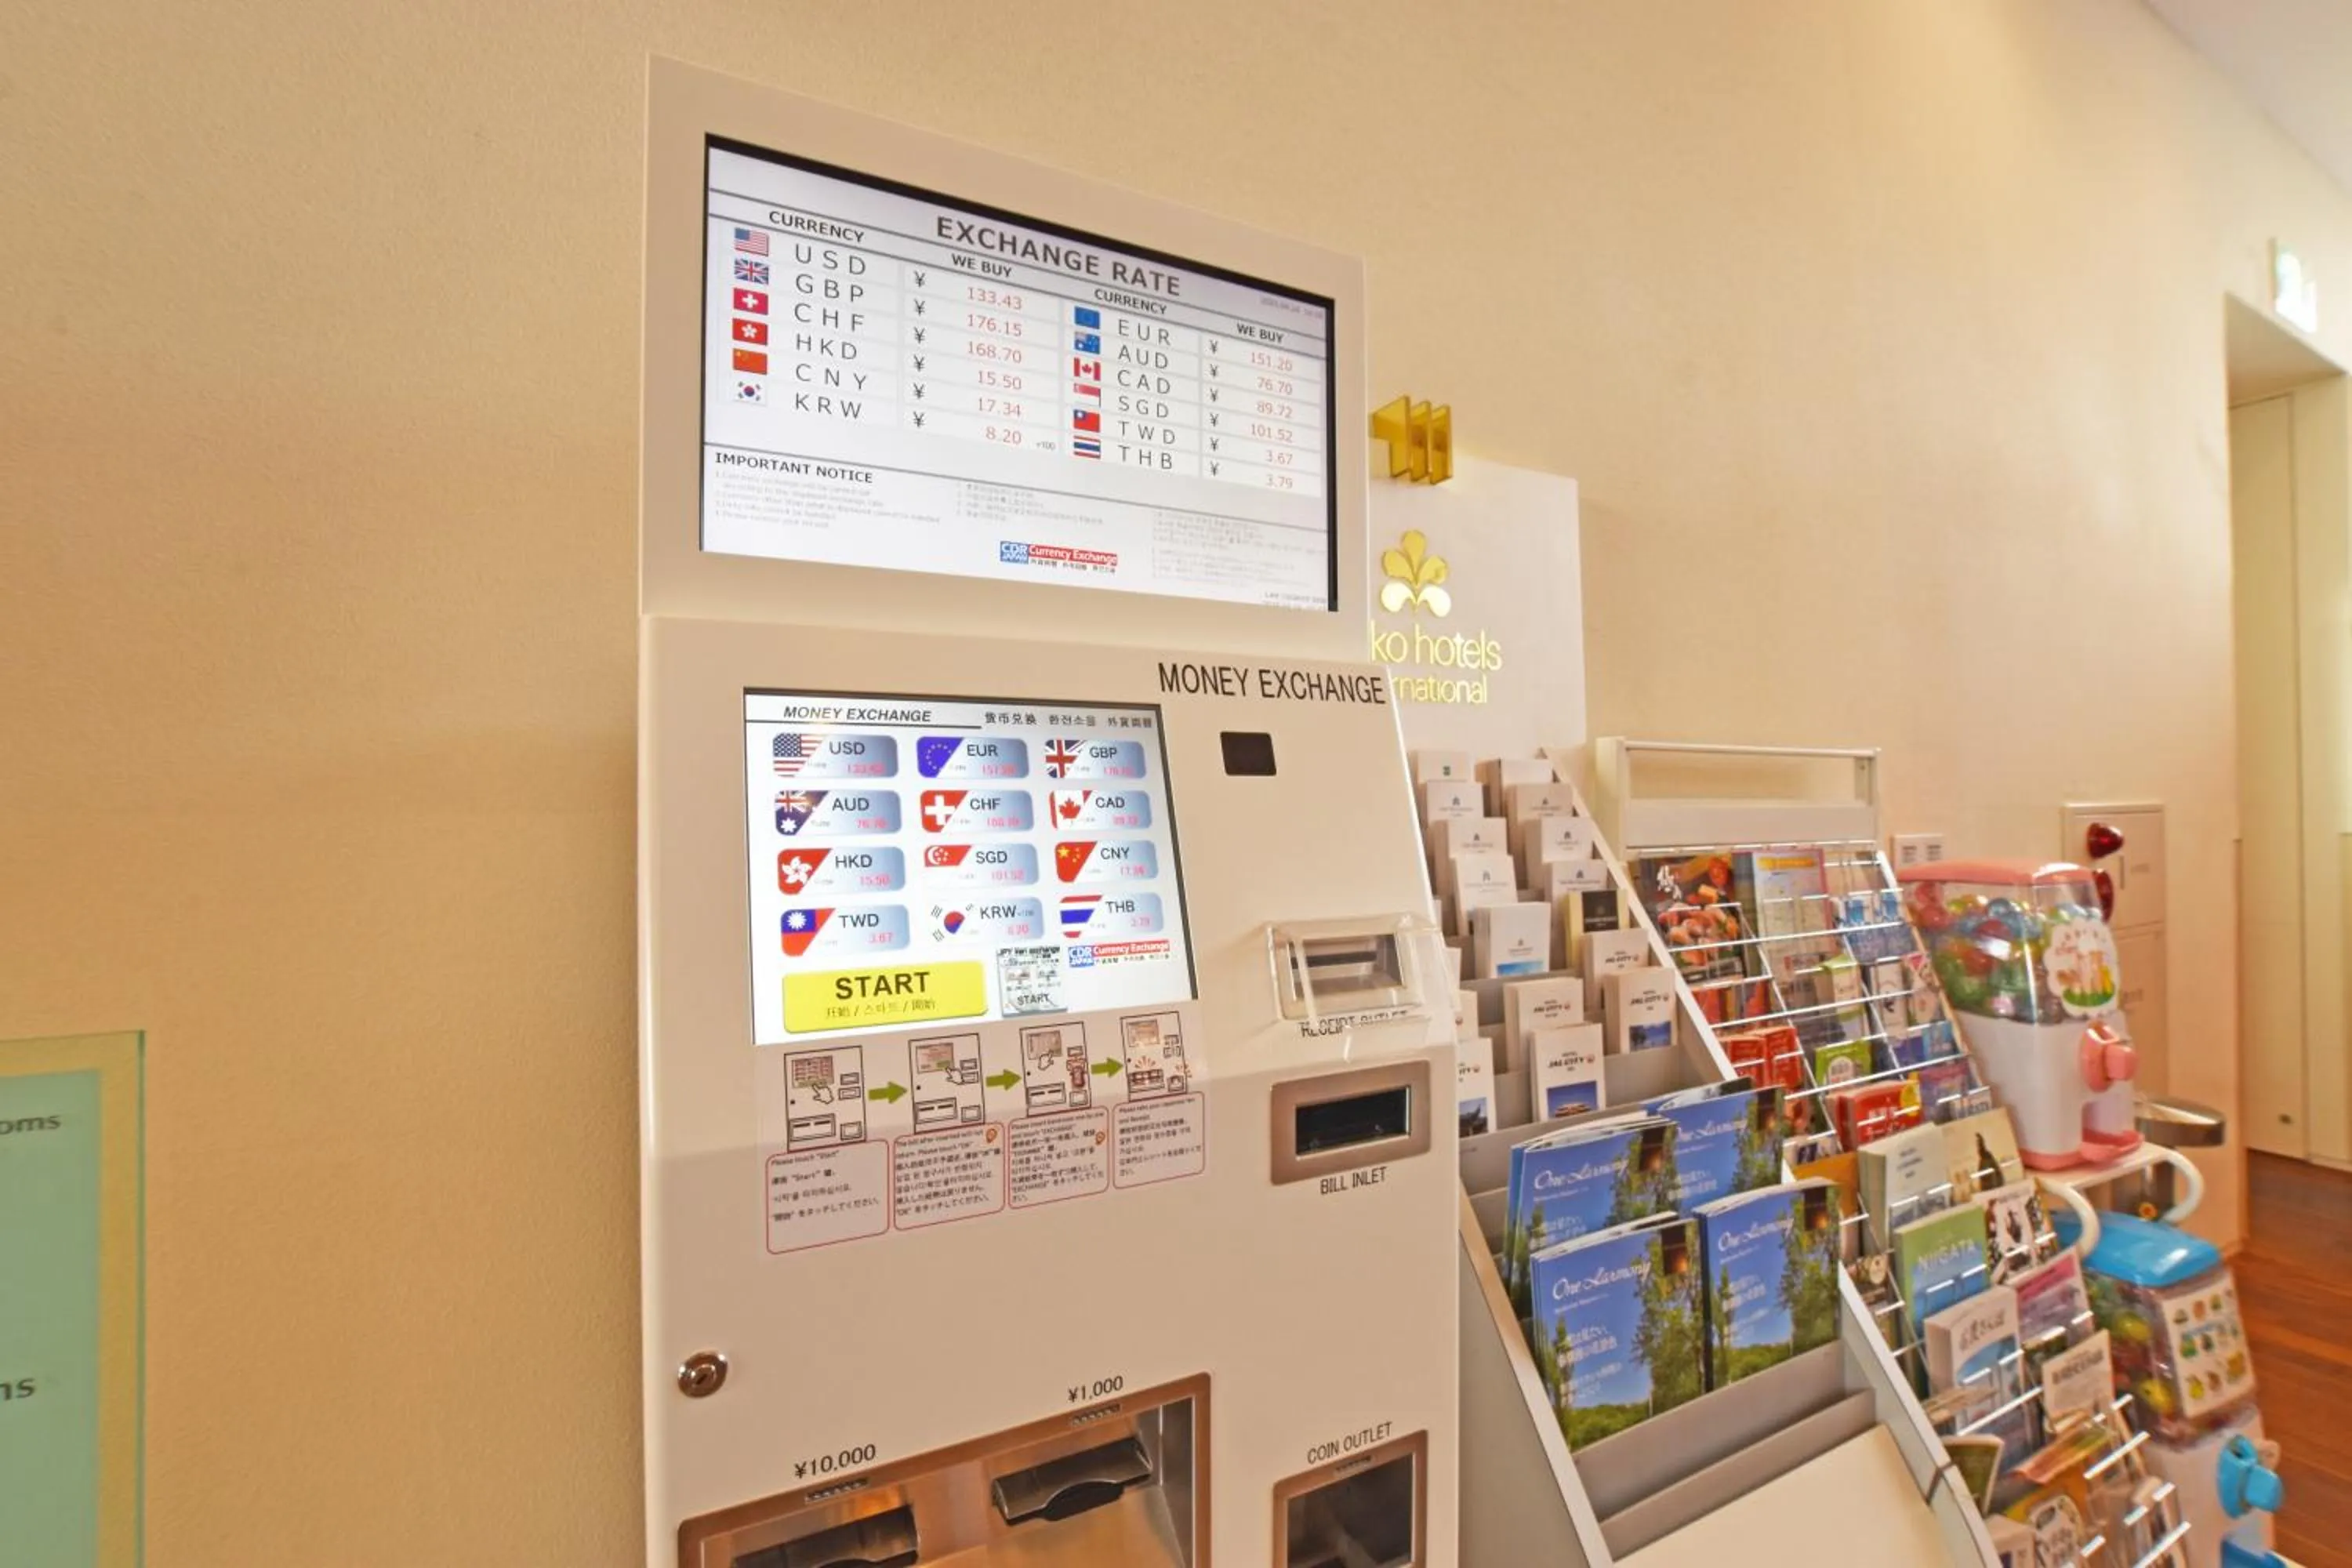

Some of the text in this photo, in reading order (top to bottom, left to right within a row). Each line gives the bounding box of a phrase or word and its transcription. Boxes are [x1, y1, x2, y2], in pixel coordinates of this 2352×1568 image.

[768, 210, 1013, 278] CURRENCY WE BUY
[937, 216, 1181, 297] EXCHANGE RATE
[793, 243, 867, 277] USD
[966, 285, 1023, 310] 133.43
[794, 274, 865, 303] GBP
[966, 312, 1022, 338] 176.15
[1094, 288, 1285, 344] CURRENCY WE BUY
[793, 303, 865, 333] CHF
[967, 340, 1022, 364] 168.70
[1117, 318, 1172, 347] EUR
[1250, 351, 1294, 373] 151.20
[794, 332, 858, 361] HKD
[977, 369, 1022, 391] 15.50
[1117, 344, 1169, 371] AUD
[1257, 376, 1294, 396] 76.70
[794, 363, 867, 391] CNY
[977, 397, 1022, 418] 17.34
[1116, 370, 1171, 396] CAD
[1256, 401, 1294, 419] 89.72
[794, 393, 862, 420] KRW
[985, 424, 1022, 445] 8.20
[1117, 396, 1169, 419] SGD
[1250, 423, 1294, 444] 101.52
[1117, 420, 1176, 445] TWD
[1265, 449, 1294, 465] 3.67
[714, 451, 811, 476] IMPORTANT
[815, 465, 873, 484] NOTICE
[1117, 445, 1174, 470] THB
[1265, 474, 1294, 490] 3.79
[1001, 542, 1117, 566] CDR Currency Exchange
[1414, 622, 1504, 672] hotels
[1158, 662, 1386, 704] MONEY EXCHANGE
[783, 706, 932, 723] MONEY EXCHANGE
[828, 741, 866, 755] USD
[967, 744, 999, 757] EUR
[1089, 746, 1118, 759] GBP
[832, 797, 870, 811] AUD
[970, 797, 1001, 811] CHF
[1095, 796, 1125, 809] CAD
[835, 854, 873, 869] HKD
[975, 851, 1008, 864] SGD
[1100, 846, 1130, 860] CNY
[838, 913, 880, 929] TWD
[979, 905, 1017, 920] KRW
[1105, 900, 1136, 913] THB
[835, 971, 931, 1000] START
[1017, 993, 1051, 1006] START
[1319, 1166, 1388, 1196] BILL INLET
[1067, 1375, 1124, 1404] ¥1,000
[1306, 1421, 1393, 1465] COIN OUTLET
[793, 1443, 877, 1480] ¥10,000
